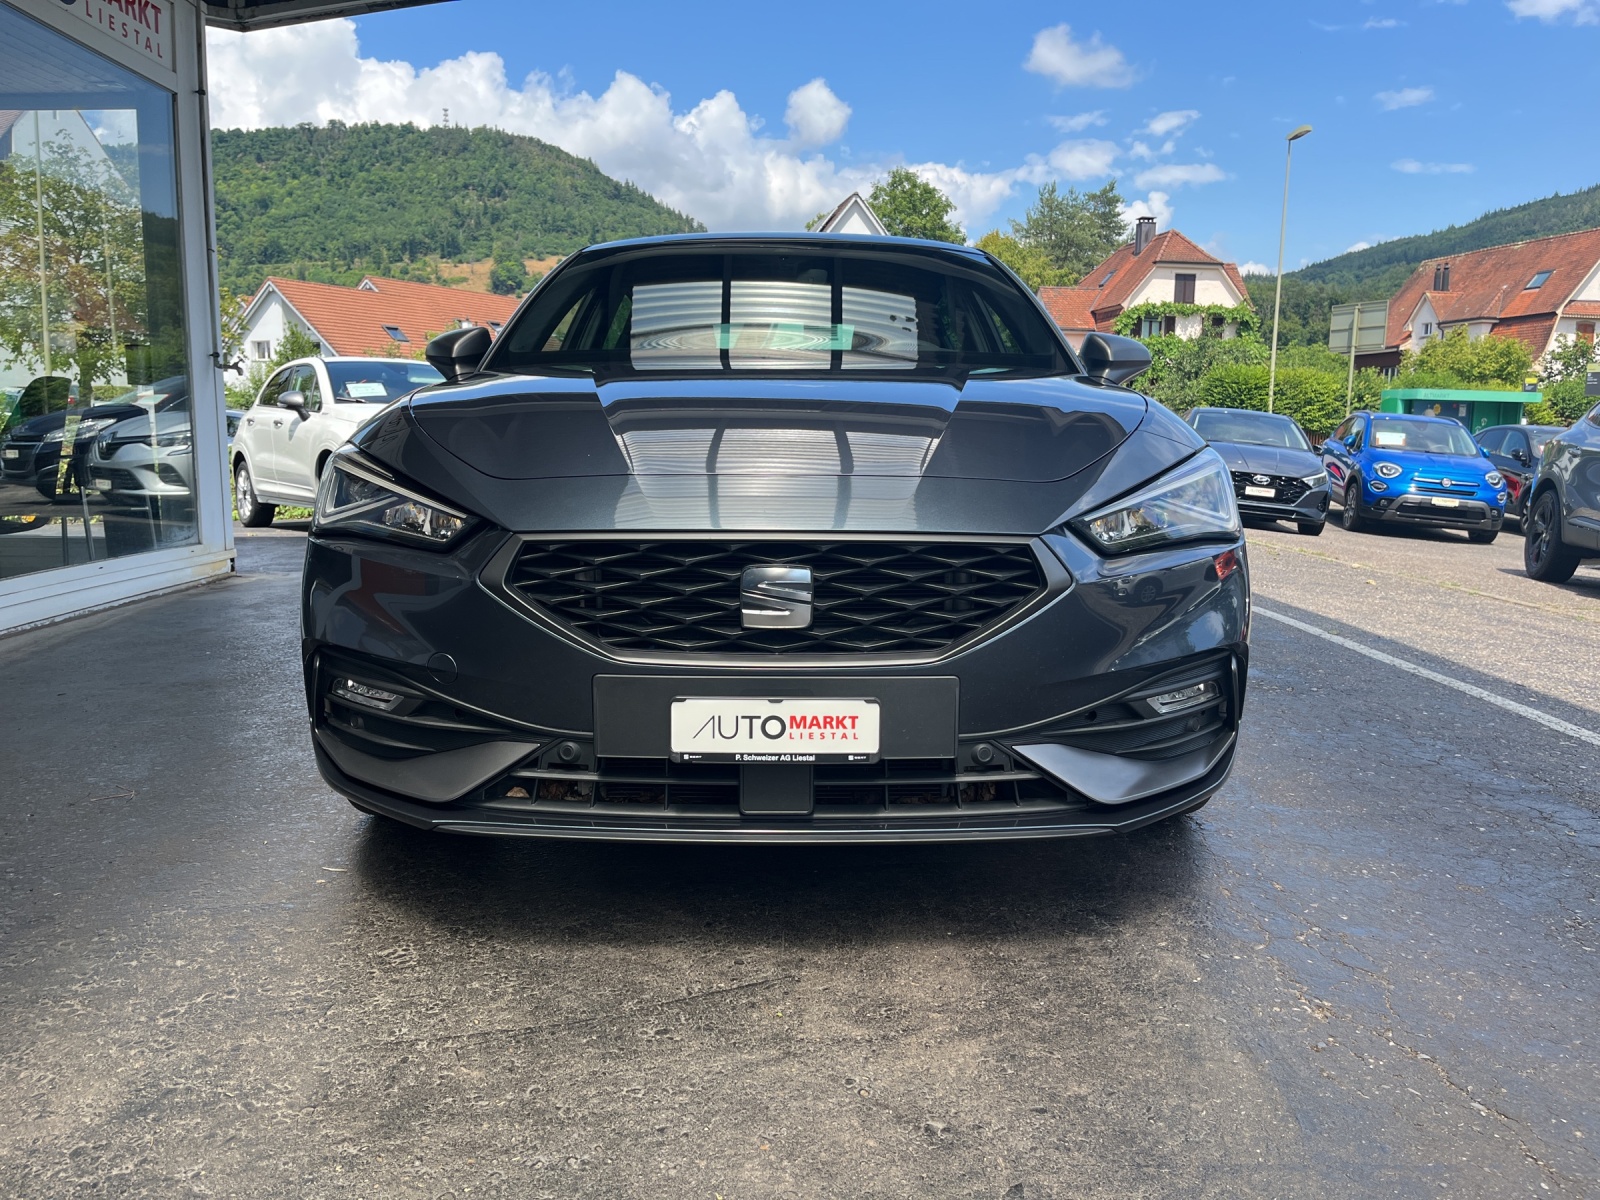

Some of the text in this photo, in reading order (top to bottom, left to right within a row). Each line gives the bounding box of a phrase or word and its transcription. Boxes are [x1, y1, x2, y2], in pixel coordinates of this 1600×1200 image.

[85, 0, 163, 59] LIESTAL
[693, 715, 859, 739] AUTO MARKT
[789, 732, 859, 740] LIESTAL
[735, 753, 742, 761] P.
[743, 753, 779, 761] Schweizer
